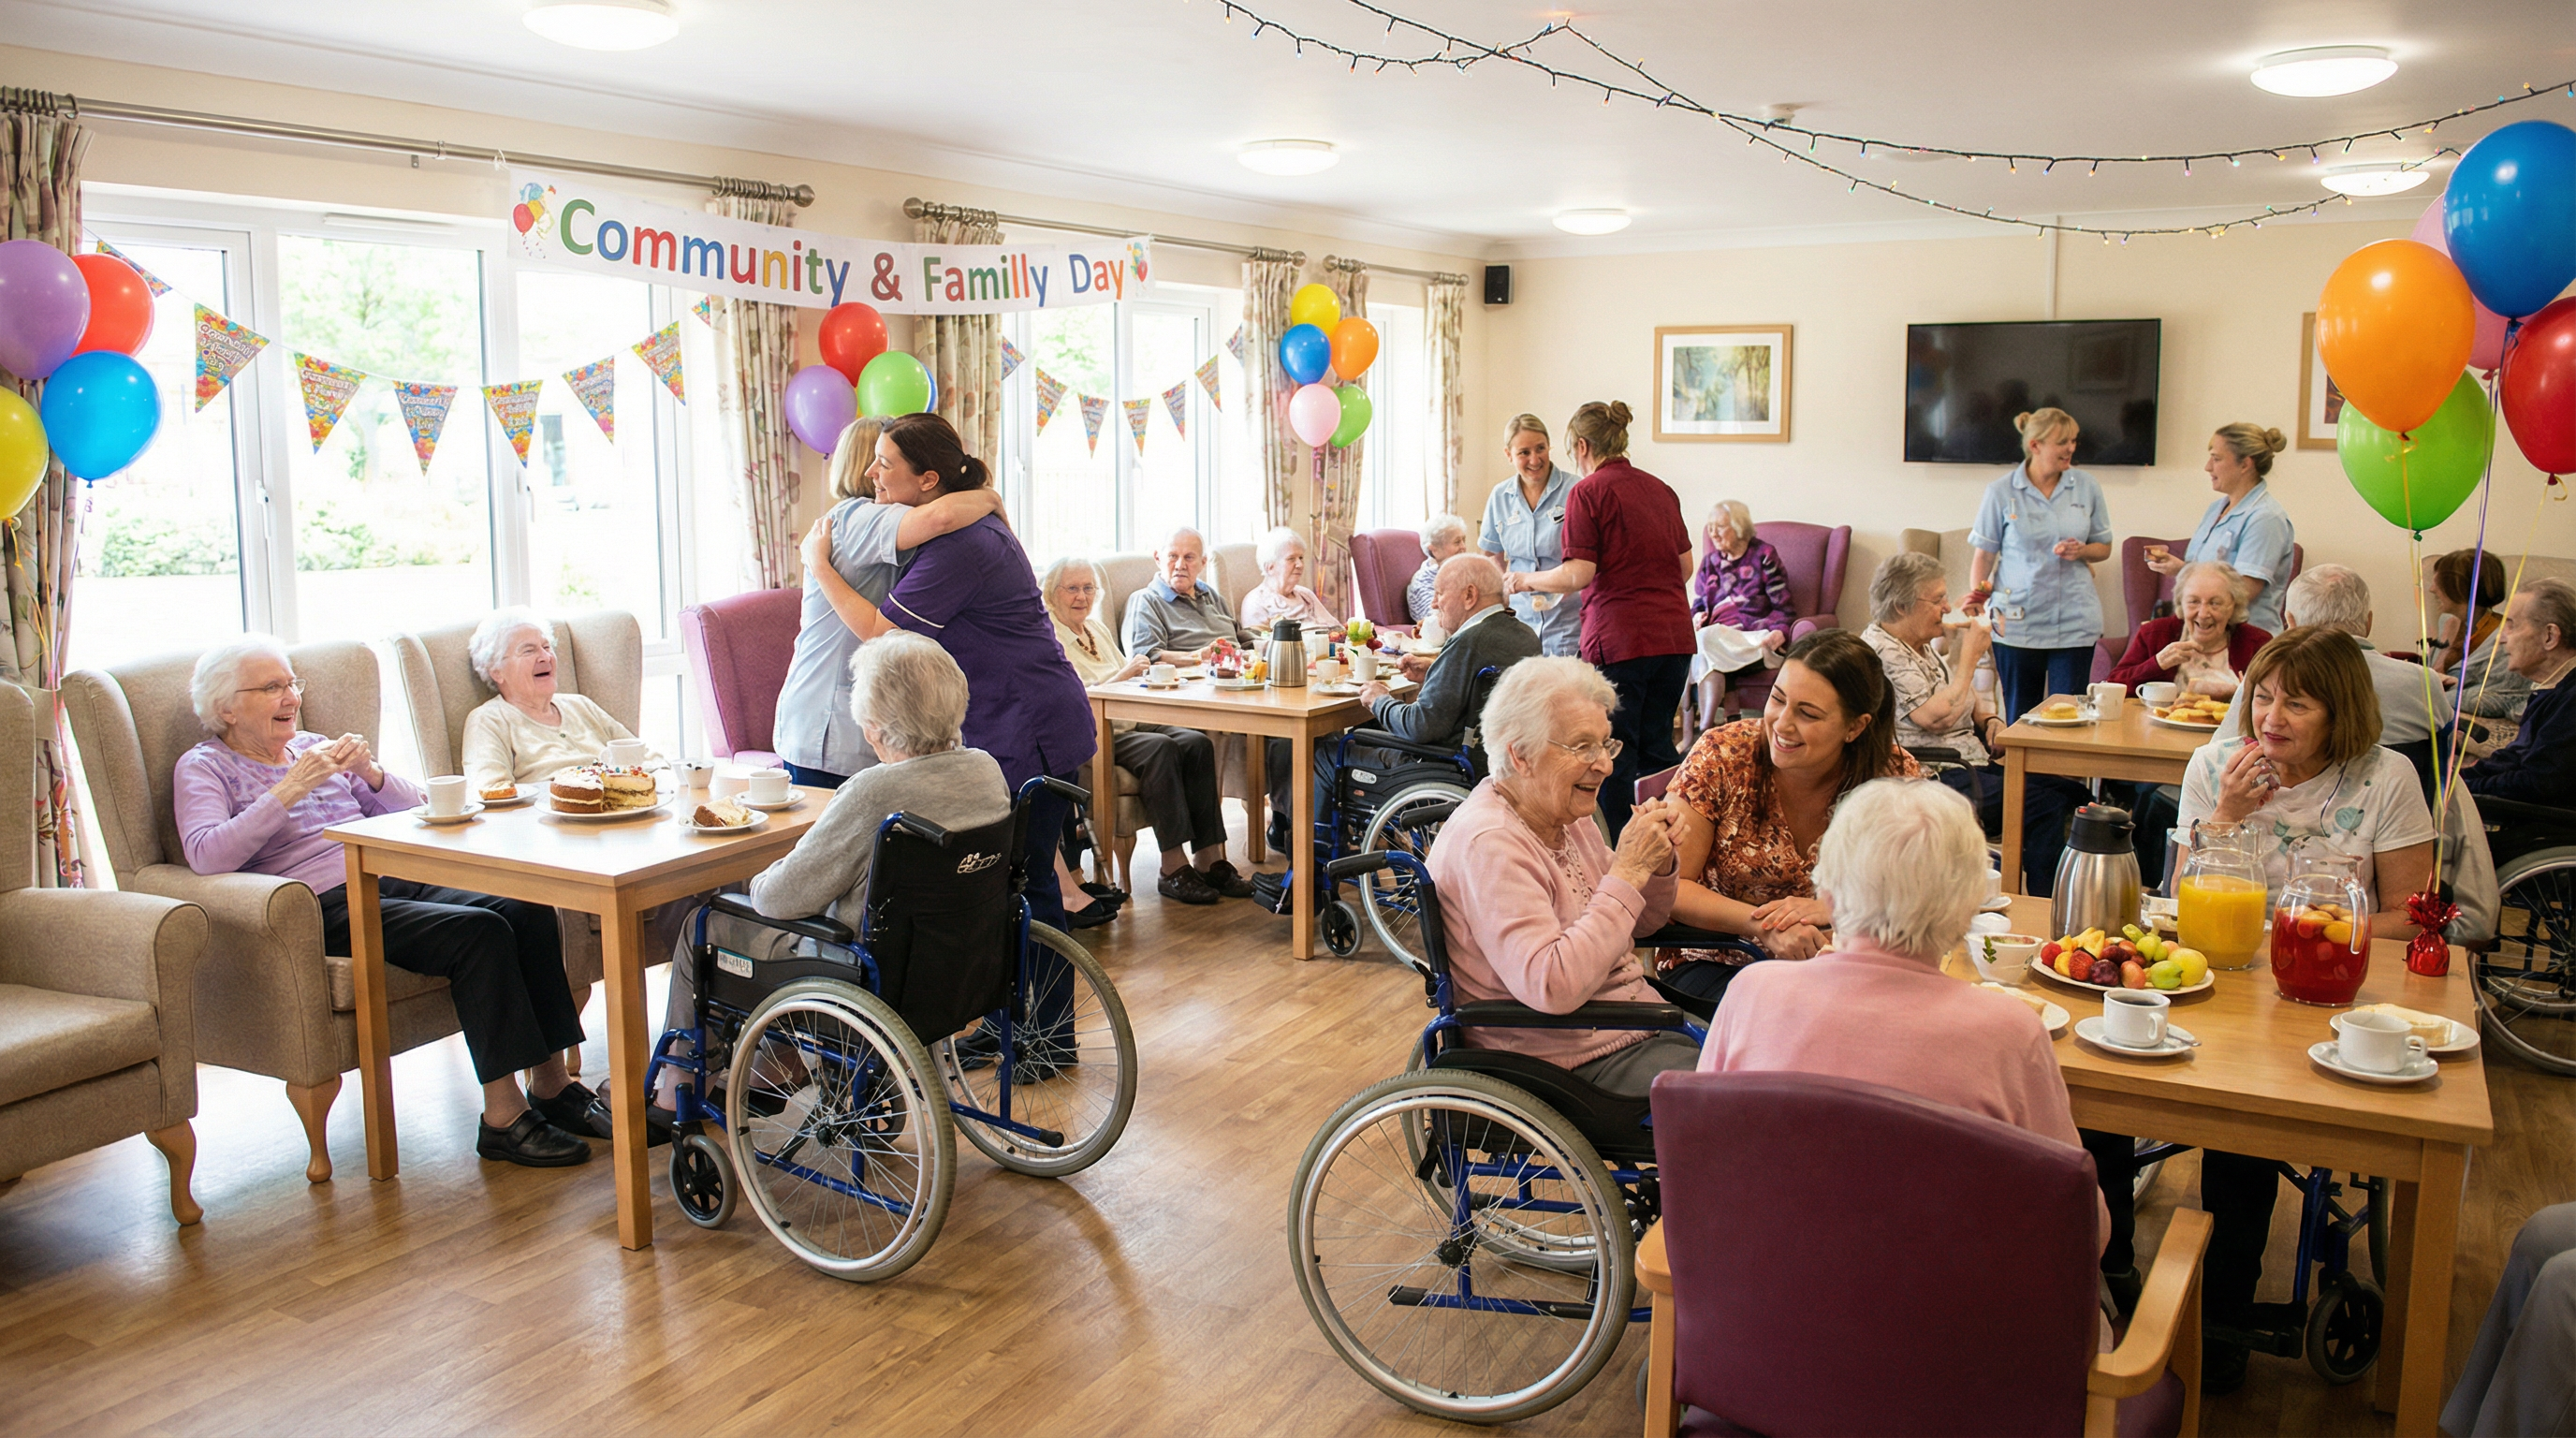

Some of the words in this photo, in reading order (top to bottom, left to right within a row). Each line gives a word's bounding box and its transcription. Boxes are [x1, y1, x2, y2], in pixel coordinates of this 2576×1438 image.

[561, 198, 851, 307] Community
[871, 252, 903, 302] &
[923, 252, 1048, 308] Familly
[1069, 254, 1125, 301] Day
